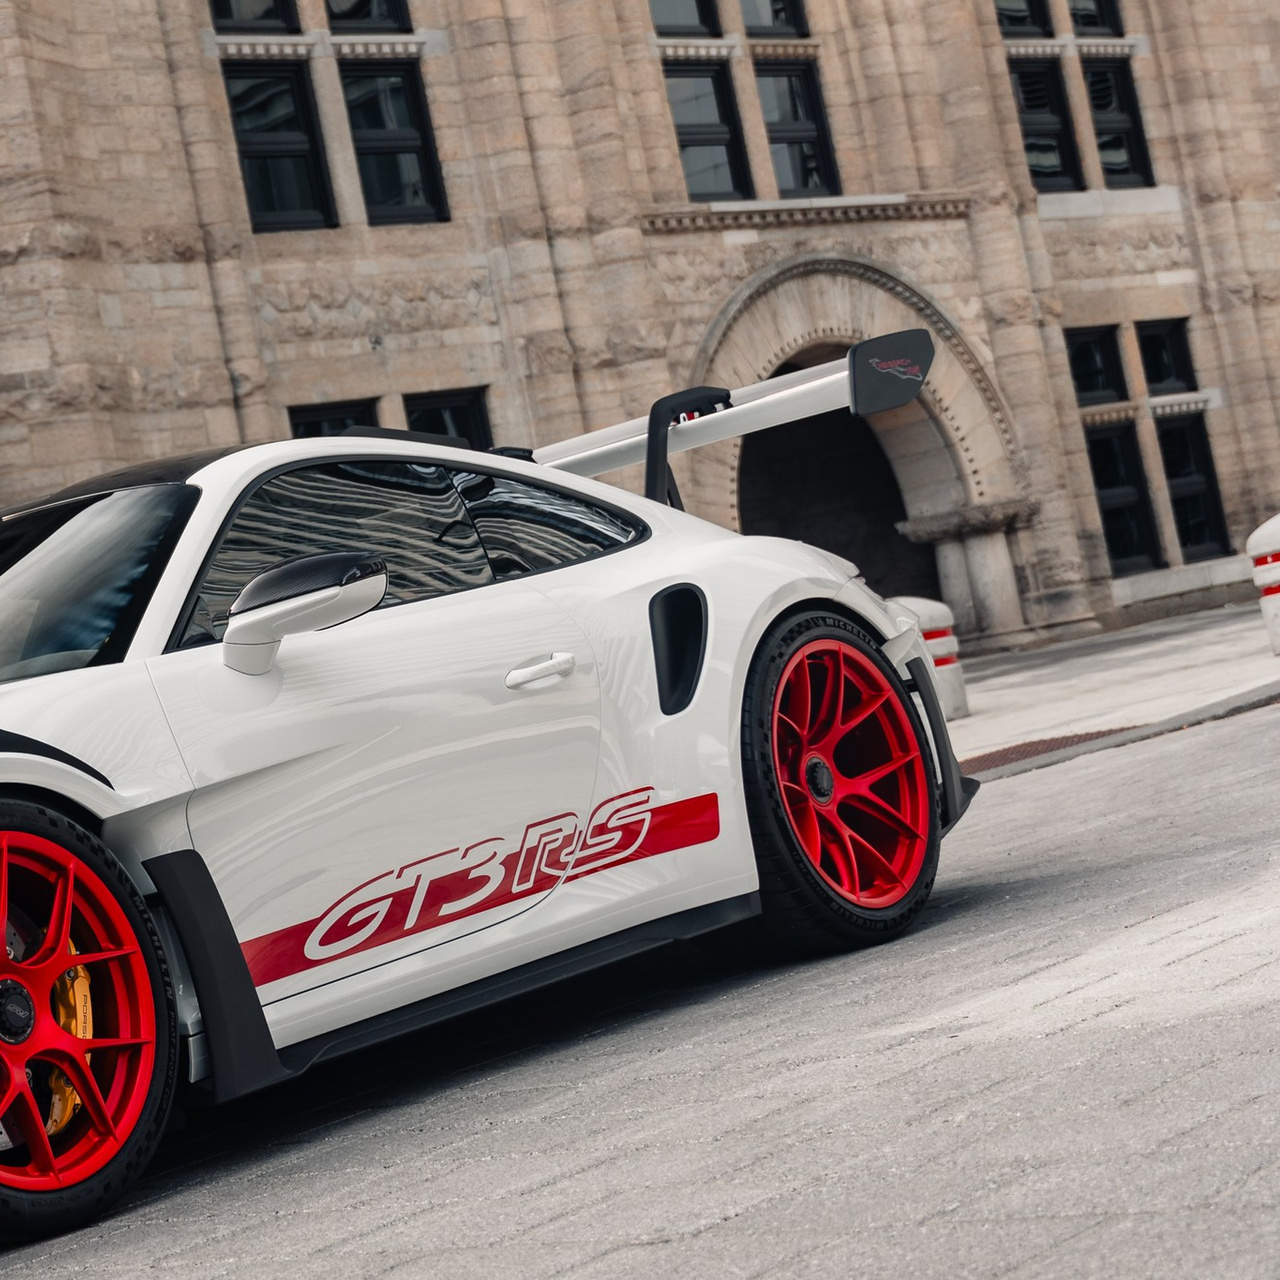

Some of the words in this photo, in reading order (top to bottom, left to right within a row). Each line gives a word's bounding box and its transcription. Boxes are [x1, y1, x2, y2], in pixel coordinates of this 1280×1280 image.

[825, 618, 877, 650] MICHELIN
[830, 902, 885, 931] MICHELIN
[132, 895, 174, 1001] MICHELIN
